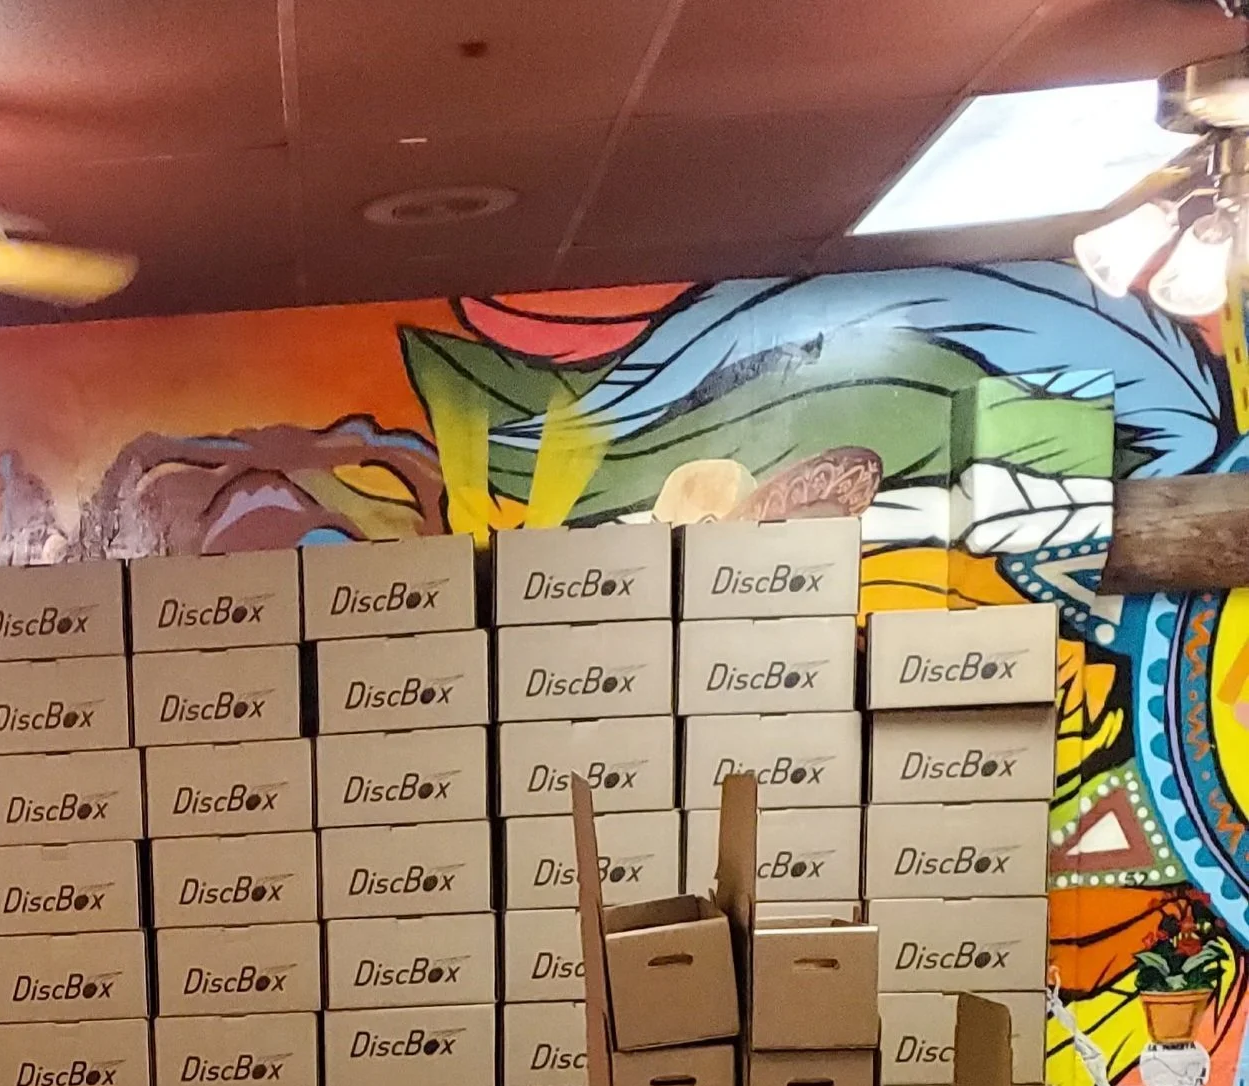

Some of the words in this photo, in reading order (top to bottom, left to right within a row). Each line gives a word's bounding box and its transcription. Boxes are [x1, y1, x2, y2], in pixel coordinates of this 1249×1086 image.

[523, 568, 634, 600] DiscBox
[711, 564, 823, 595] DiscBox
[157, 595, 264, 629] DiscBox
[330, 582, 439, 616] DiscBox
[525, 666, 635, 698] DiscBox
[706, 661, 818, 692] DiscBox
[899, 651, 1017, 684] DiscBox
[160, 691, 265, 723] DiscBox
[344, 677, 453, 710] DiscBox
[528, 762, 637, 793] DisBox
[900, 749, 1016, 780] DiscBox
[172, 784, 278, 815] DiscBox
[343, 772, 451, 804] DiscBox
[6, 793, 109, 824] DiscBox
[534, 856, 644, 887] DisBox
[894, 846, 1010, 876] DiscBox
[178, 875, 283, 905] DiscBox
[348, 865, 455, 896] DiscBox
[3, 884, 105, 914] DiscBox
[895, 941, 1009, 970] DiscBox
[12, 973, 114, 1002] DiscBox
[183, 965, 287, 995] DiscBox
[353, 957, 461, 987] DiscBox
[349, 1029, 456, 1058] DiscBox
[530, 1043, 588, 1070] Disc
[895, 1036, 956, 1063] Disc
[180, 1054, 283, 1082] DiscBox
